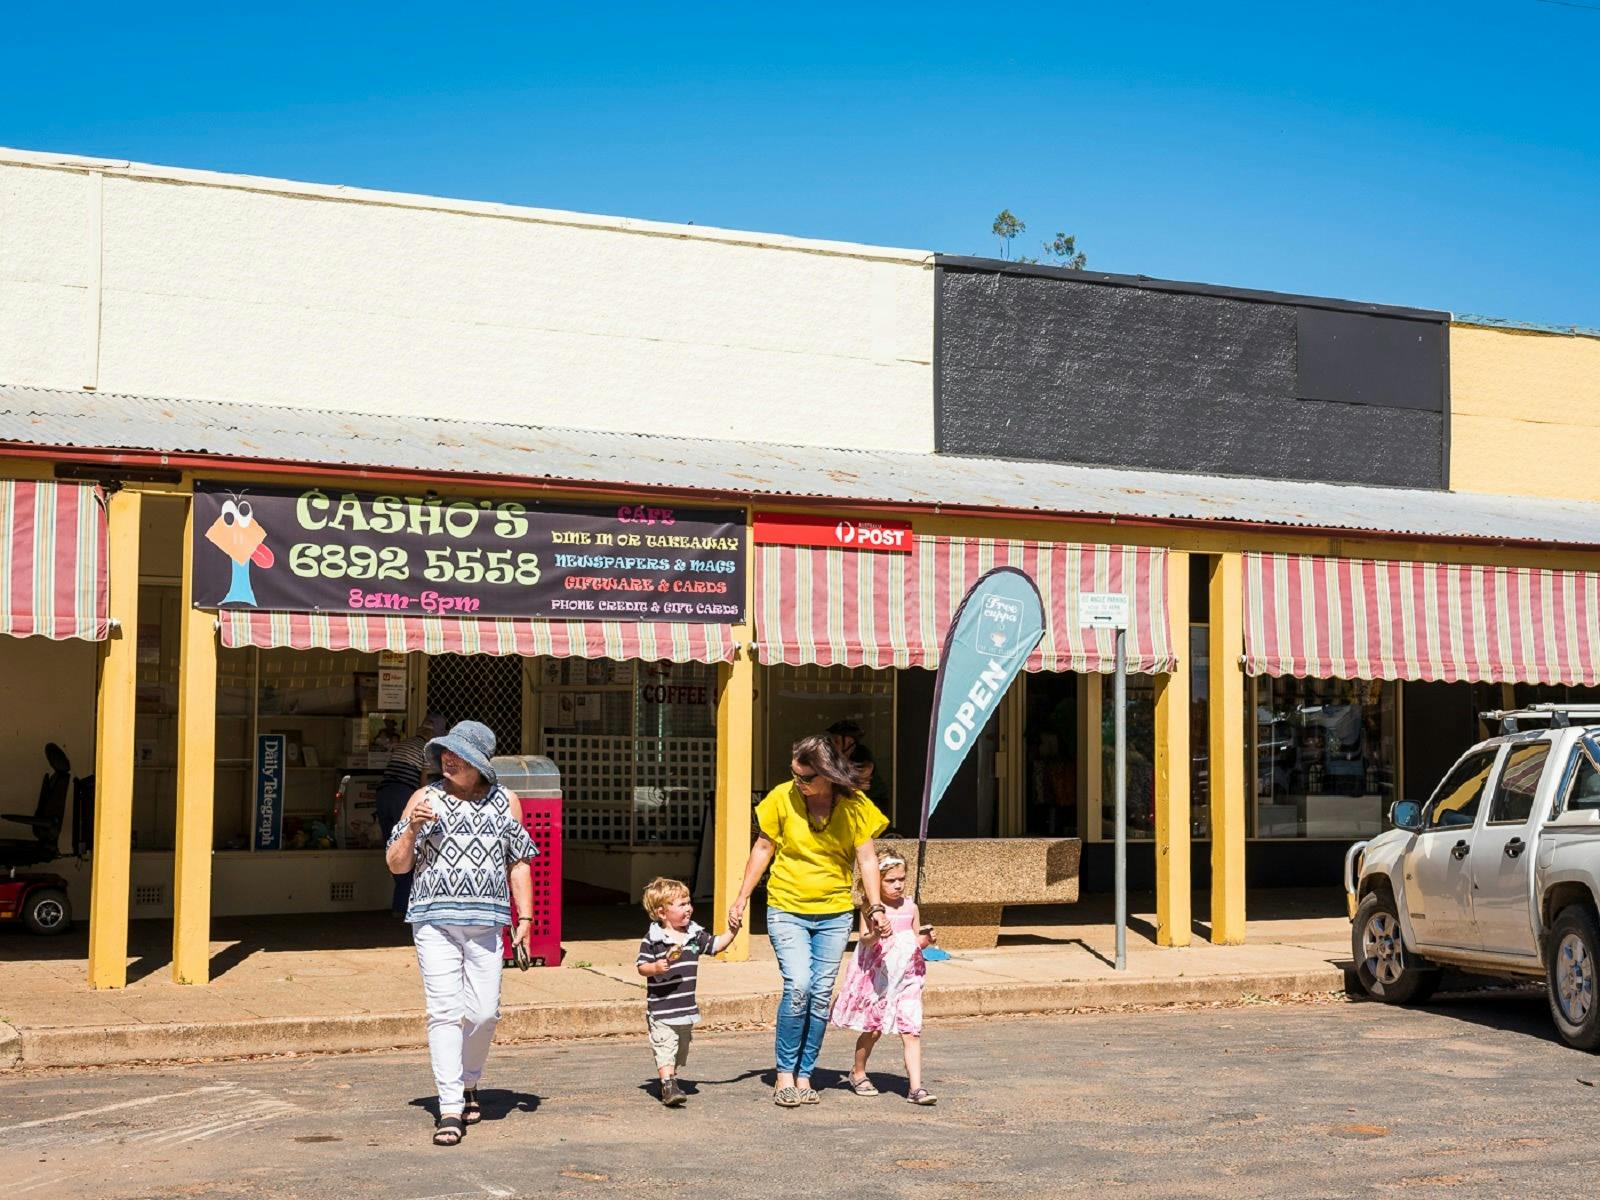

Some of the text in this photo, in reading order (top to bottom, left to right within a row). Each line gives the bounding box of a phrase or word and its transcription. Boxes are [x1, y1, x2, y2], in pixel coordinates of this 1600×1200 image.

[296, 489, 529, 539] CASHO'S
[551, 530, 739, 551] DINE IN OR TAKEAWAY
[857, 528, 905, 546] POST
[288, 543, 542, 586] 6892 5558
[554, 553, 736, 573] NEWSPAPERS & MAGS
[564, 575, 728, 594] GIFTWARE & CARDS
[349, 588, 480, 615] 8am-6pm
[551, 599, 739, 615] PHONE CREDIT & GIFT CARDS
[985, 597, 1018, 614] Free
[983, 609, 1018, 623] cuppa
[642, 684, 708, 705] COFFEE
[943, 658, 1009, 751] OPEN
[259, 740, 279, 845] Daily Telegraph
